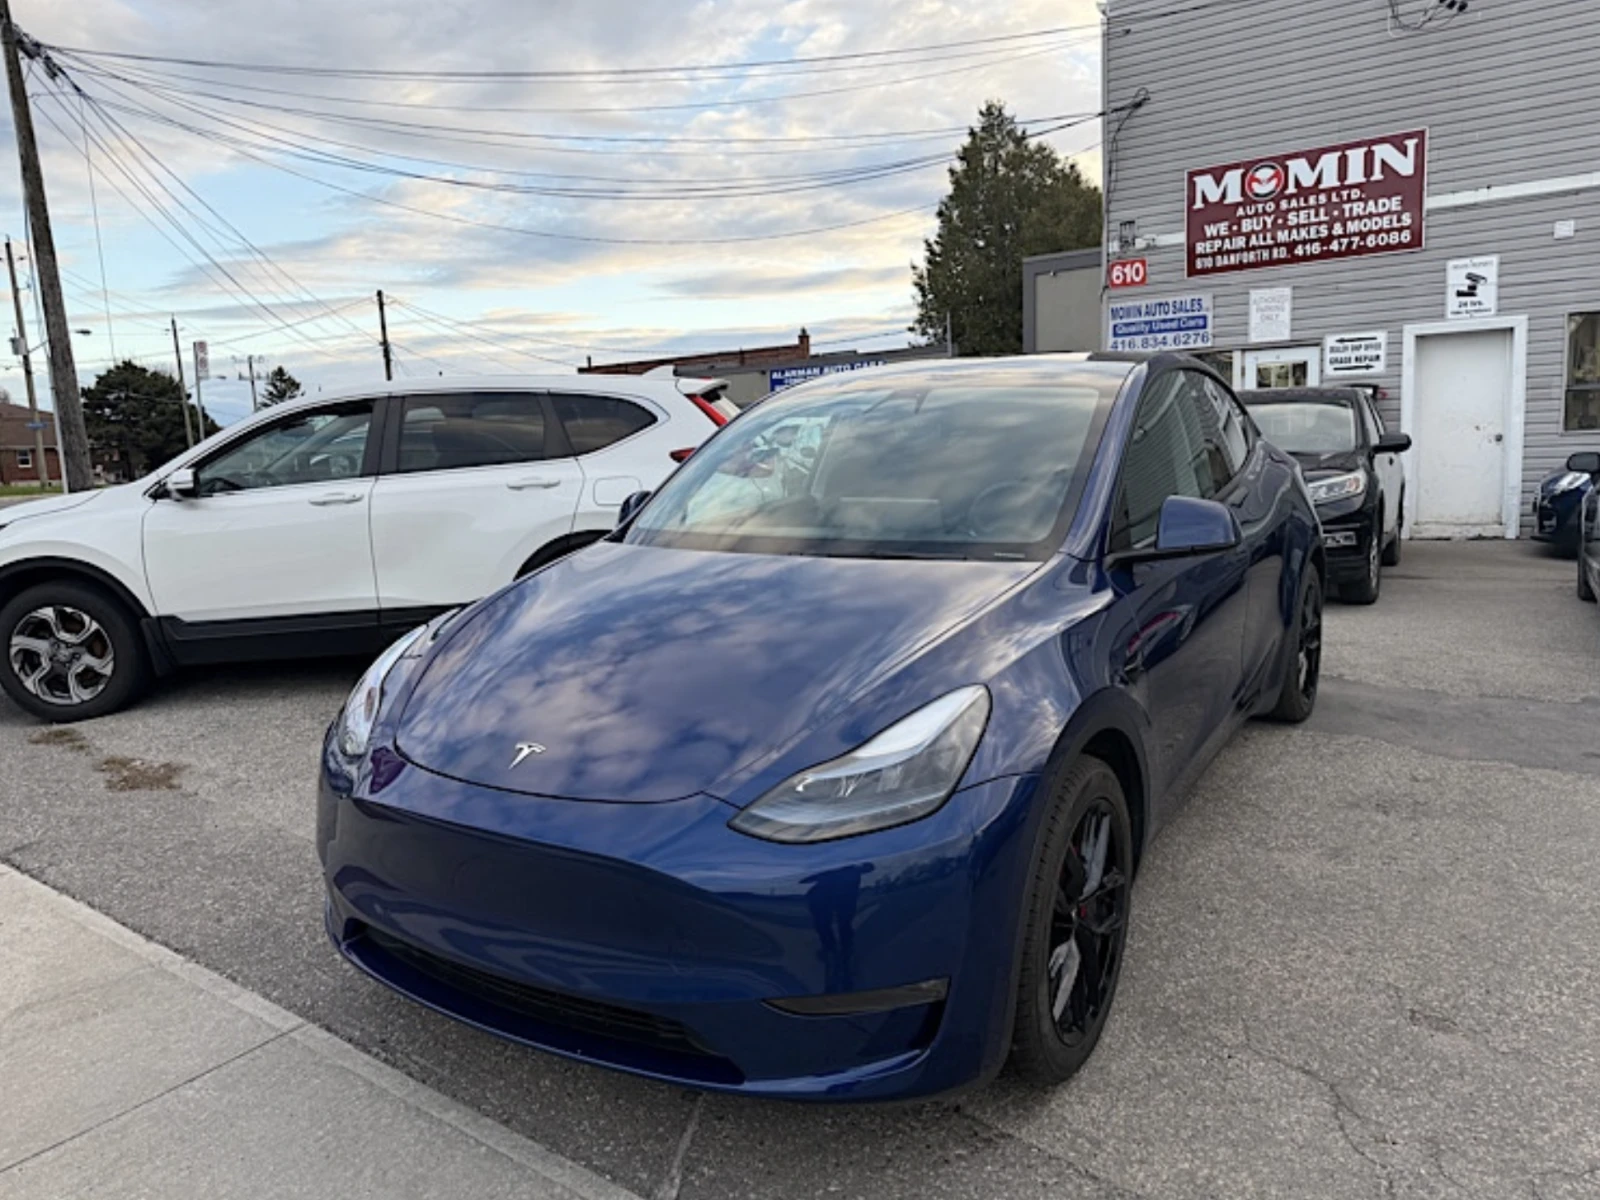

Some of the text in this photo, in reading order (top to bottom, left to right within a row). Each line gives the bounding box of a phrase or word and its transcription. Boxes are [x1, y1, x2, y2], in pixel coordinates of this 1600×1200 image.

[1192, 138, 1419, 209] MOMIN
[1204, 196, 1402, 238] WE BUY SELL TRADE
[1236, 188, 1367, 217] AUTO SALES LTD.
[1195, 212, 1412, 254] REPAIR ALL MAKES & MODELS
[1215, 250, 1270, 267] DANFORTH
[1294, 229, 1411, 256] 416-477-6086
[1111, 262, 1145, 285] 610
[1144, 301, 1170, 317] AUTO
[1172, 298, 1203, 314] SALES
[1115, 316, 1205, 335] Quality Used Cars
